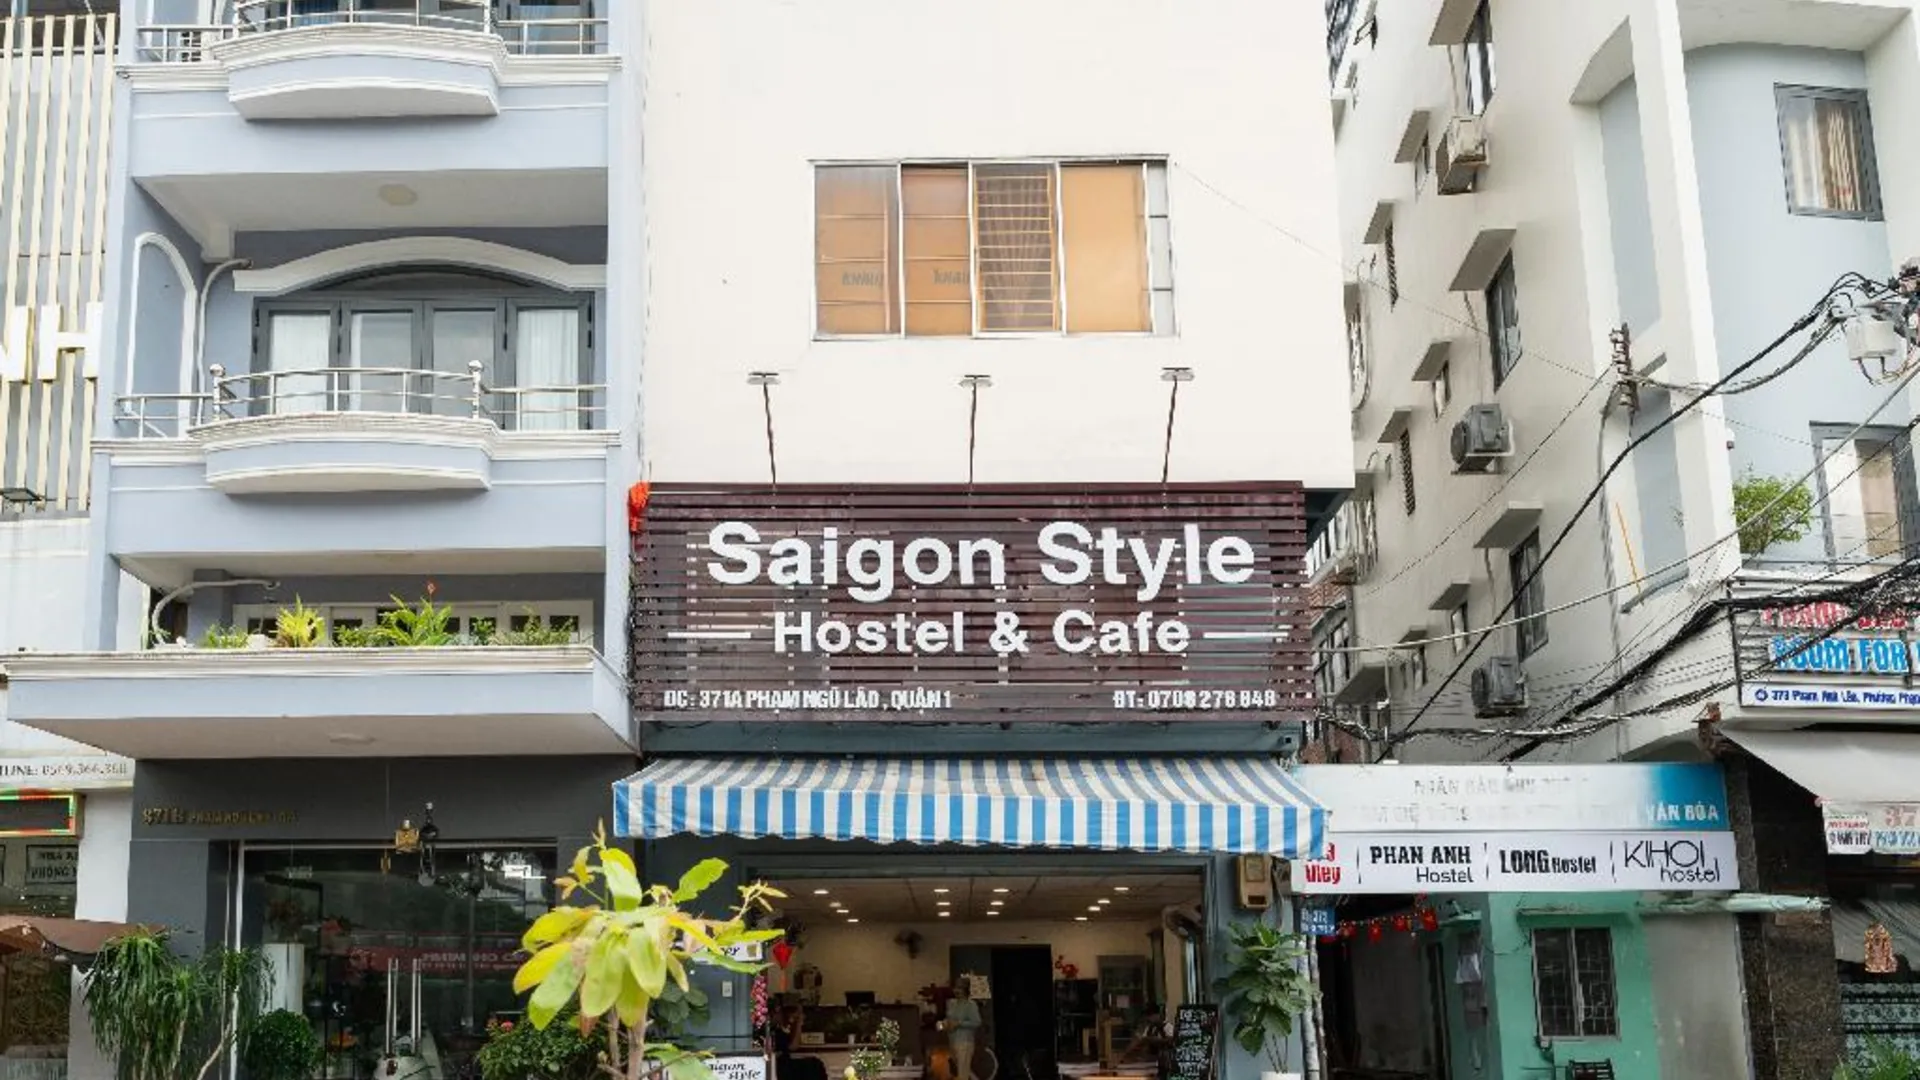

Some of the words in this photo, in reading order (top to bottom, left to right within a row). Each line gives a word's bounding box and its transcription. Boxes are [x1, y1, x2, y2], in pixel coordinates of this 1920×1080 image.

[706, 521, 1005, 602] Saigon
[1038, 520, 1255, 602] Style
[774, 611, 965, 653] Hostel
[989, 611, 1030, 654] &
[1053, 609, 1191, 654] Cafe
[1857, 637, 1909, 674] FOR
[699, 690, 743, 709] 371A
[1370, 846, 1424, 864] PHAN
[1431, 846, 1472, 864] ANH
[1500, 849, 1550, 874] LONG
[1552, 856, 1597, 874] Hostel
[1416, 867, 1474, 883] Hostel
[1660, 857, 1721, 883] hostel
